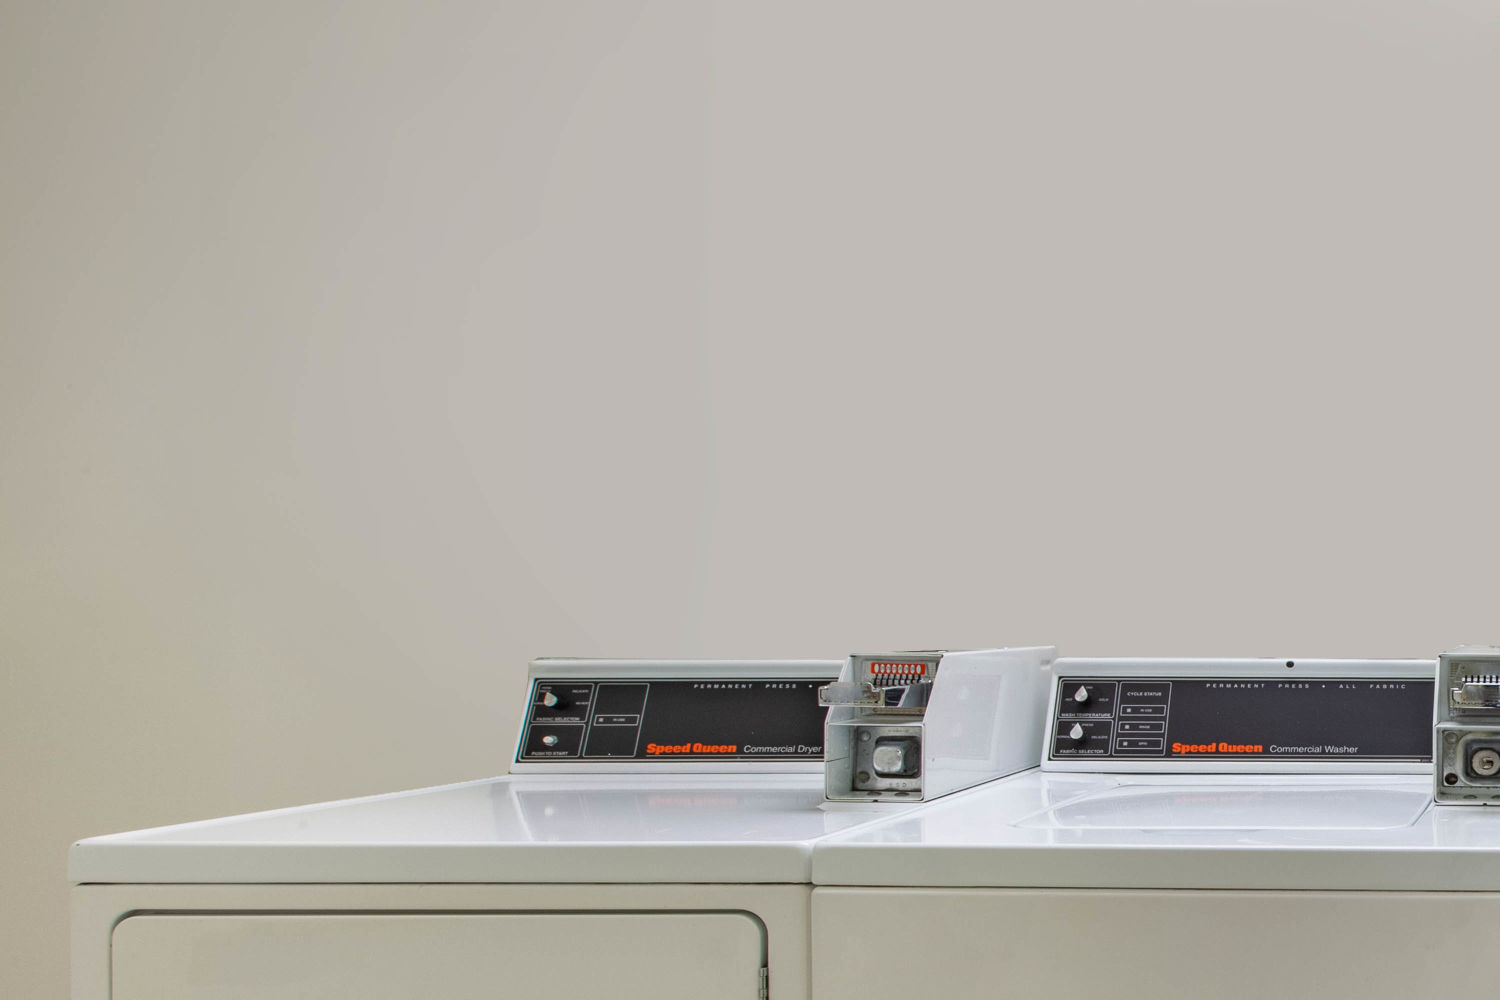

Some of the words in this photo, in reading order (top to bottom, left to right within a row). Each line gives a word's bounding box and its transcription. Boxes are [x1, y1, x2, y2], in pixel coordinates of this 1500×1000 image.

[646, 743, 691, 755] Speed
[692, 743, 737, 753] Queen
[743, 744, 796, 753] Commercial
[797, 744, 823, 754] Dryer
[1171, 742, 1217, 755] Speed
[1217, 742, 1263, 753] Queen
[1269, 744, 1323, 754] Commercial
[1324, 745, 1359, 754] Washer
